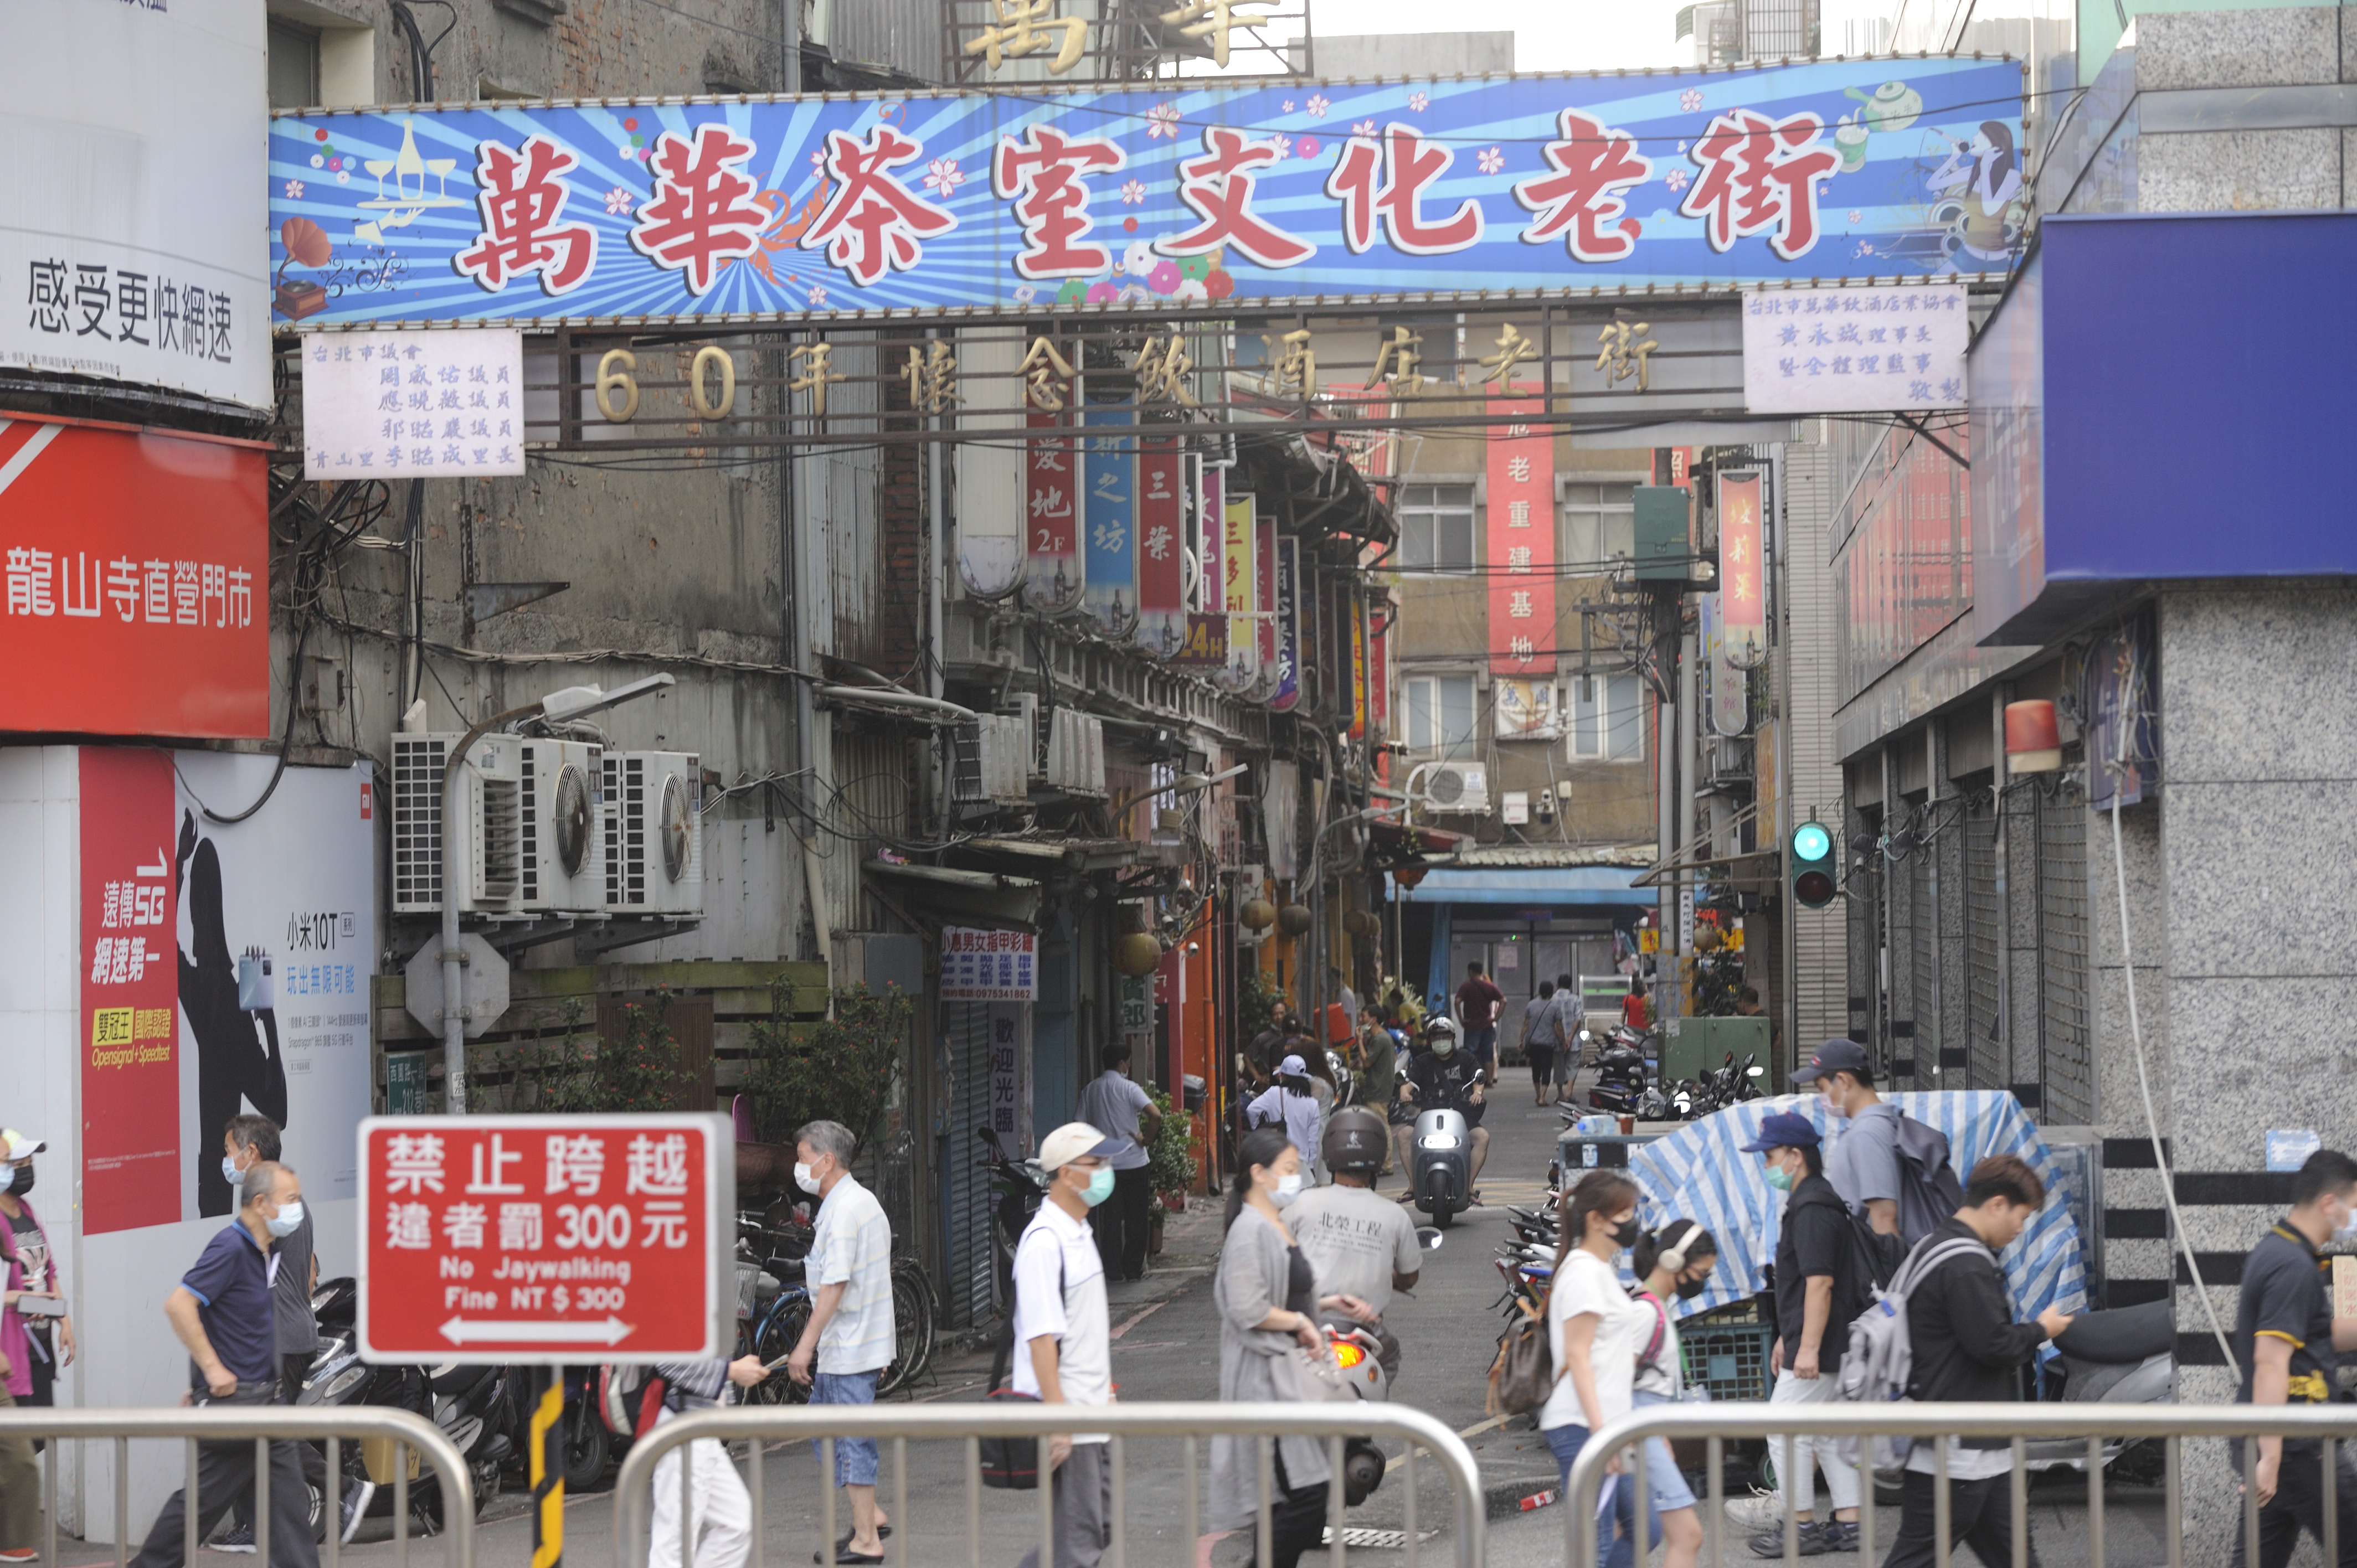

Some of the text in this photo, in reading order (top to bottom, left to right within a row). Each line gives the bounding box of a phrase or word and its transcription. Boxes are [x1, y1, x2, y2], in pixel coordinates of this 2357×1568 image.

[453, 107, 1842, 297] 萬華茶室文化老街
[28, 258, 232, 364] 感受更快網速
[313, 342, 423, 362] 台北市議會
[380, 364, 511, 387] 周威佑議員
[1908, 378, 1964, 403] 敬製
[378, 389, 511, 412] 應曉薇議員
[1143, 471, 1173, 561] 三葉
[1507, 410, 1533, 663] 危老重建基地
[1036, 528, 1066, 552] 2F
[6, 546, 252, 629] 龍山寺直營門市
[102, 880, 166, 929] 遠傳5G
[91, 936, 161, 985] 網速第一
[287, 964, 354, 994] 玩出無限可能
[97, 1008, 172, 1043] 雙冠王 國際認證
[995, 1017, 1014, 1133] 歡迎光臨
[386, 1132, 688, 1196] 禁止跨越
[439, 1255, 631, 1286] No Jaywalking
[445, 1287, 498, 1311] Fine
